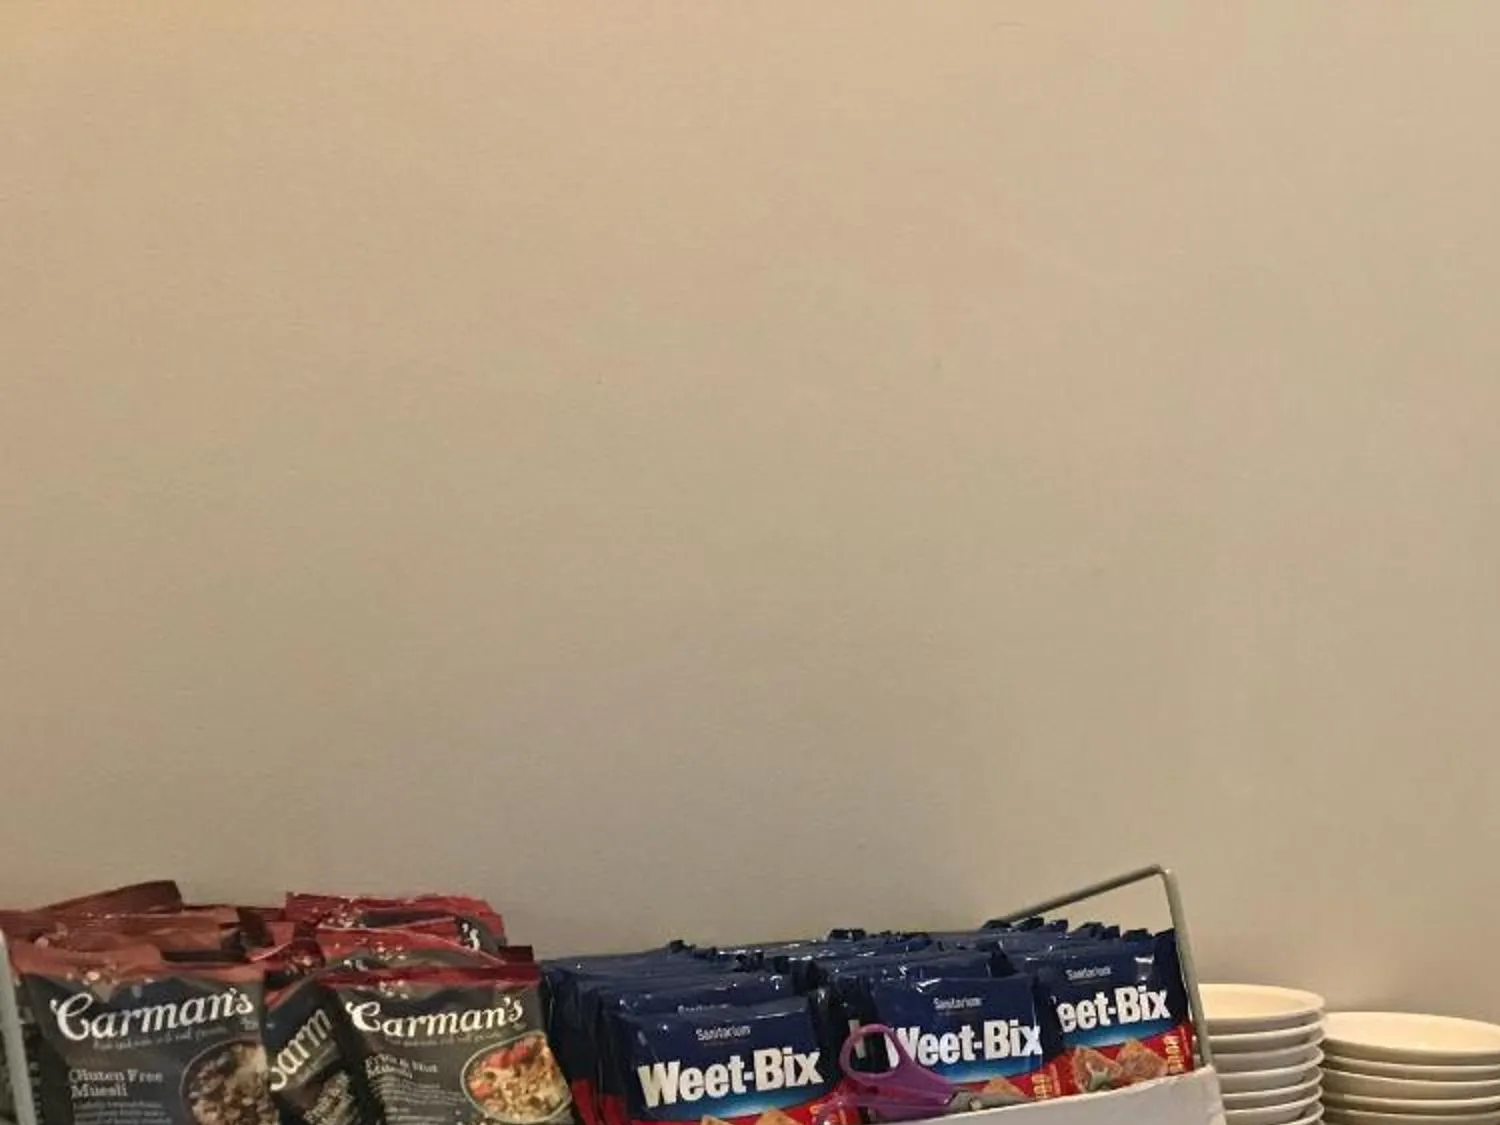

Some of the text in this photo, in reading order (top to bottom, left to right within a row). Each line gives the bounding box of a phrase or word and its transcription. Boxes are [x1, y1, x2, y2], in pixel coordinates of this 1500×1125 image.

[50, 987, 254, 1041] Carman's
[345, 996, 524, 1038] Carman's
[1050, 984, 1171, 1033] eet-Bix
[70, 1082, 128, 1098] Muesli
[127, 1068, 164, 1083] Free
[637, 1047, 824, 1108] Weet-Bix
